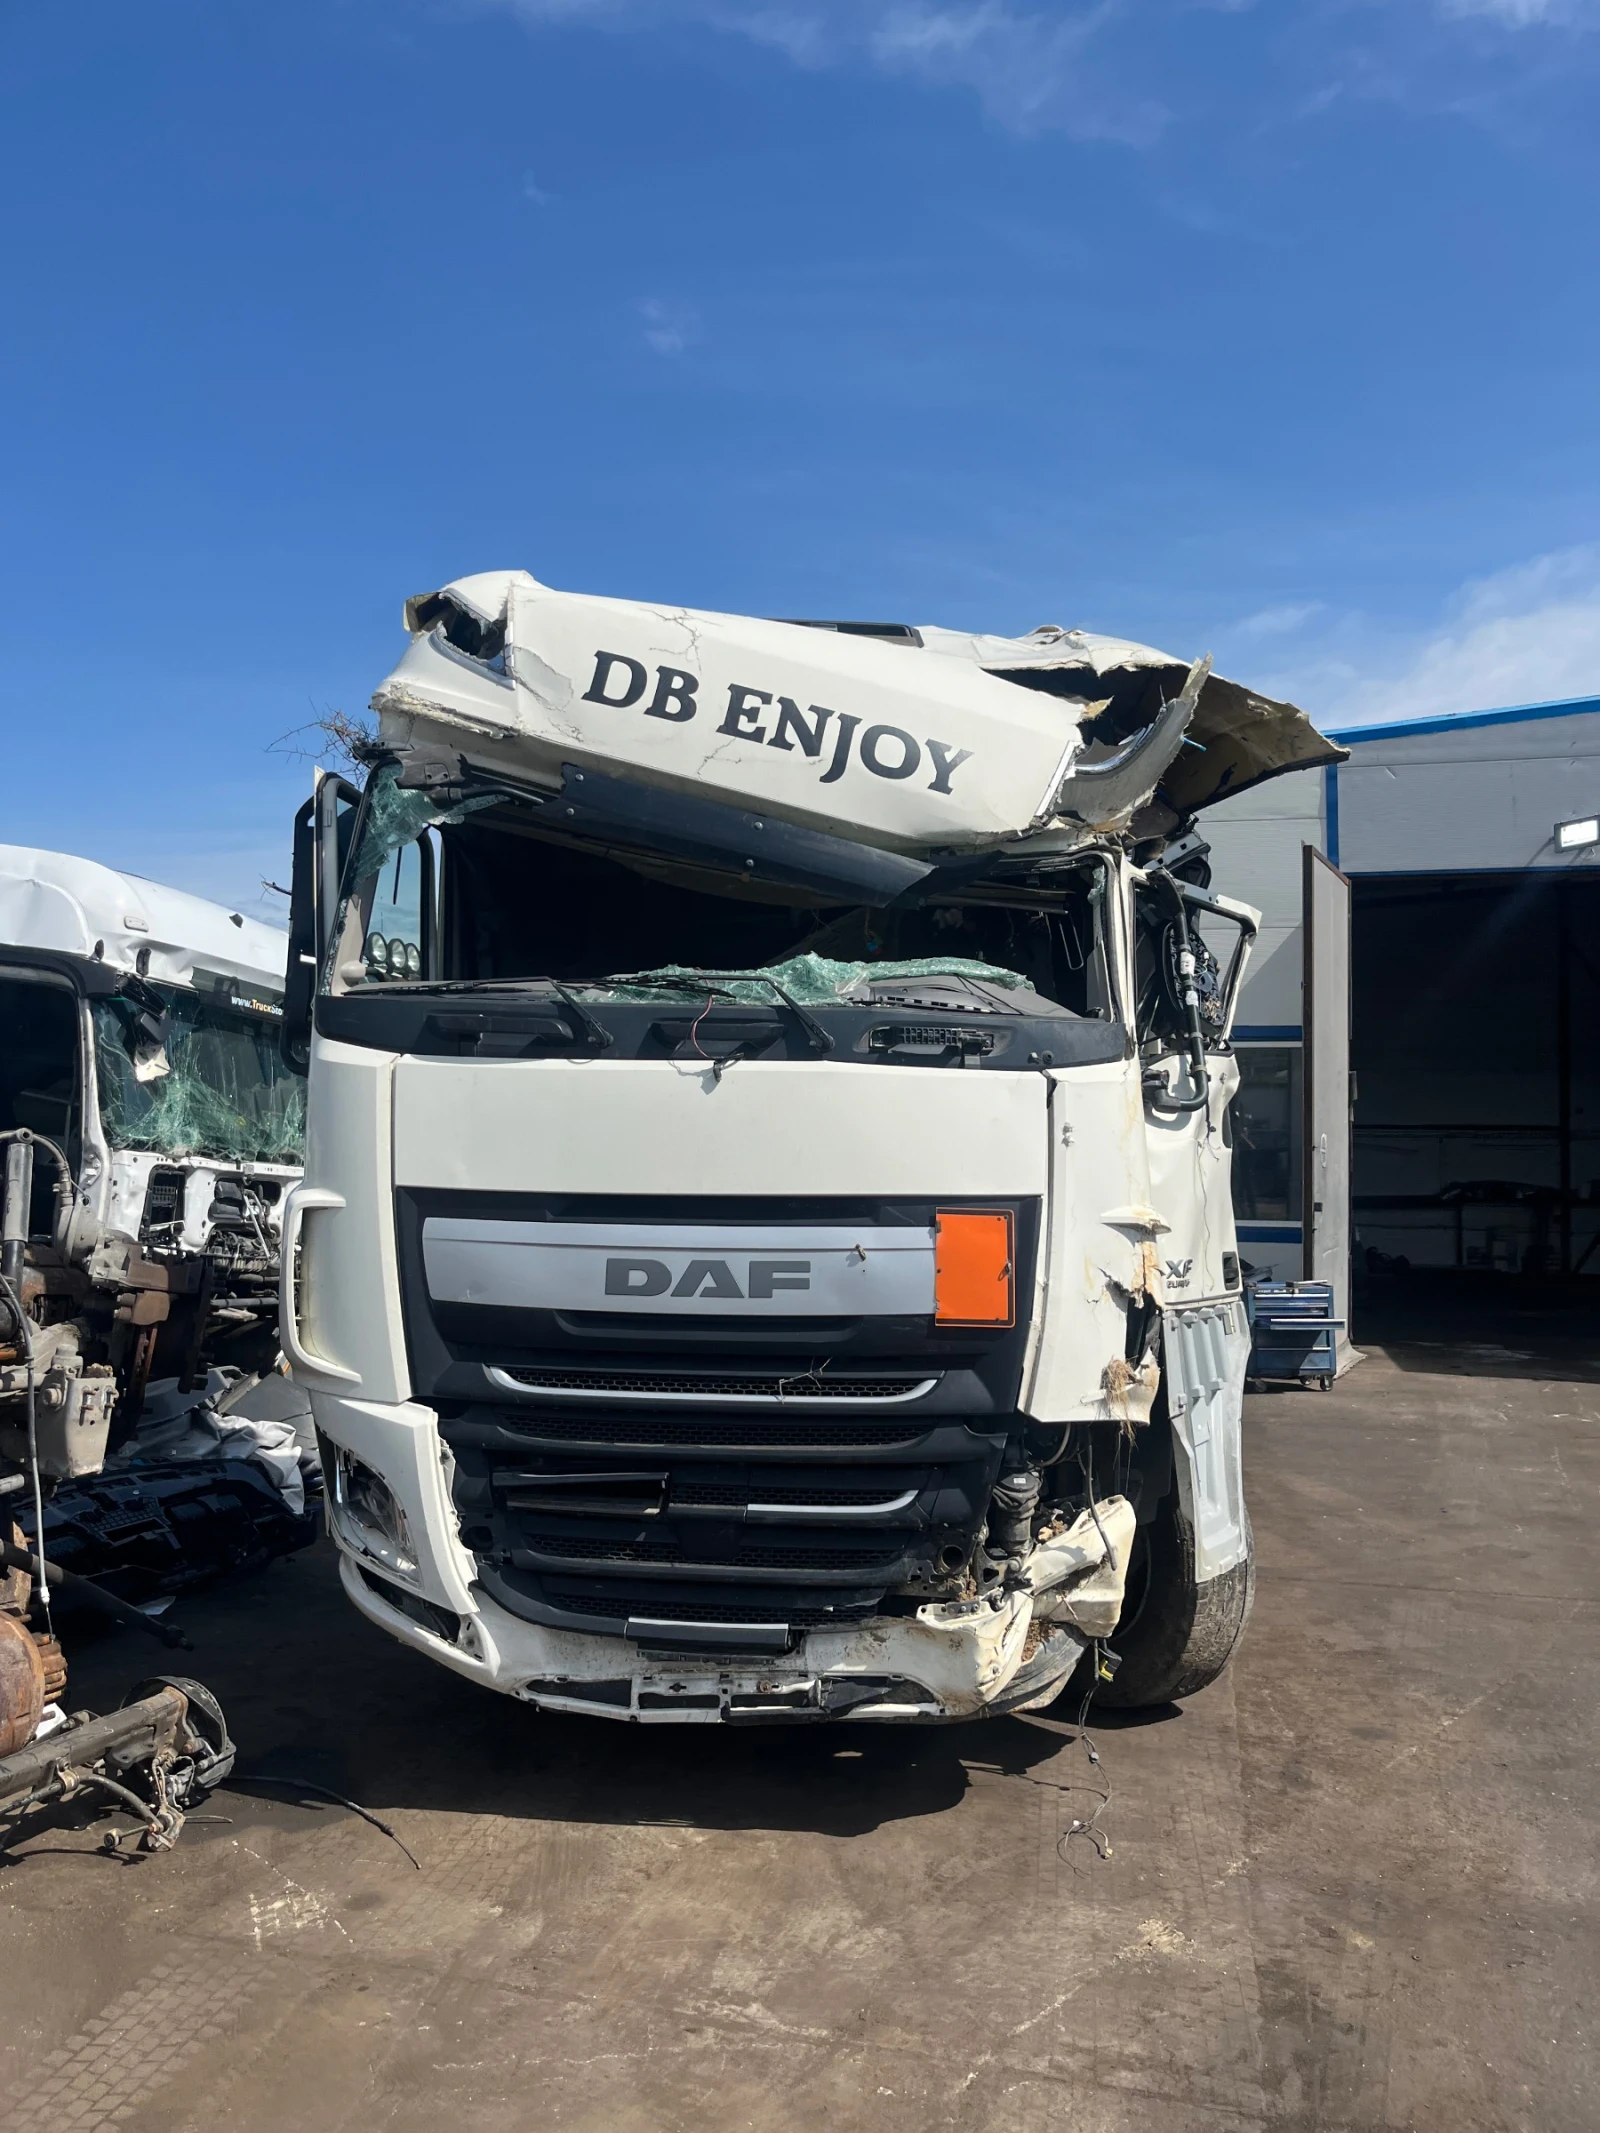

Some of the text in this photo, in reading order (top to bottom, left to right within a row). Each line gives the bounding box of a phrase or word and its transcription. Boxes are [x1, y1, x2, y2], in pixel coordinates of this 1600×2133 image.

[581, 650, 974, 795] DB ENJOY
[231, 996, 284, 1016] www.TruckSto
[605, 1258, 811, 1298] DAF
[1165, 1259, 1193, 1279] XF
